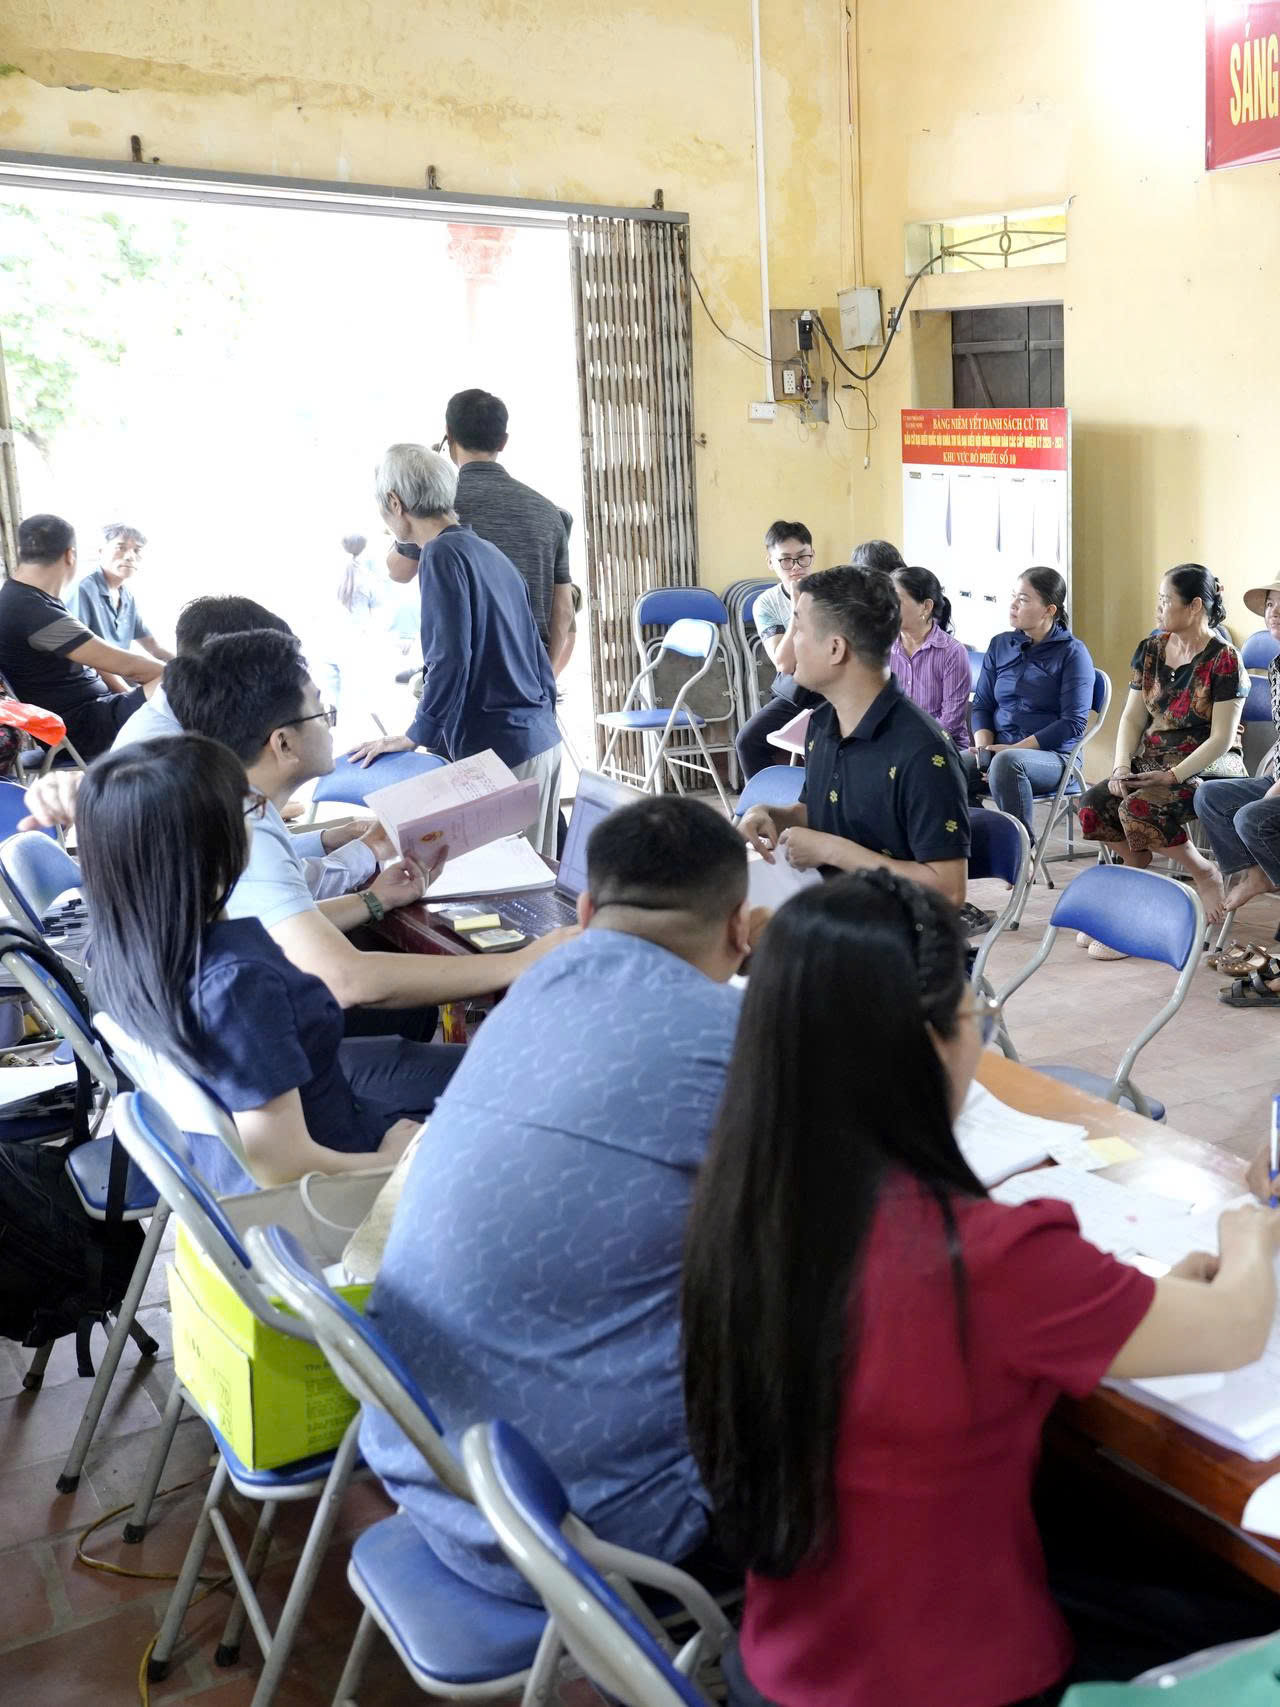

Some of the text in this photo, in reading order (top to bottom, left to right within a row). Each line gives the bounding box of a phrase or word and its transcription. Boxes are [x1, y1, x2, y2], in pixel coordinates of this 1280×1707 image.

[1230, 21, 1279, 126] SÁNG
[969, 412, 982, 430] YẾT
[983, 417, 1002, 430] DANH
[1003, 414, 1022, 431] SÁCH
[1035, 417, 1049, 431] TRI
[943, 451, 956, 463] KHU
[980, 448, 999, 465] PHIẾU
[1000, 448, 1009, 465] SỐ
